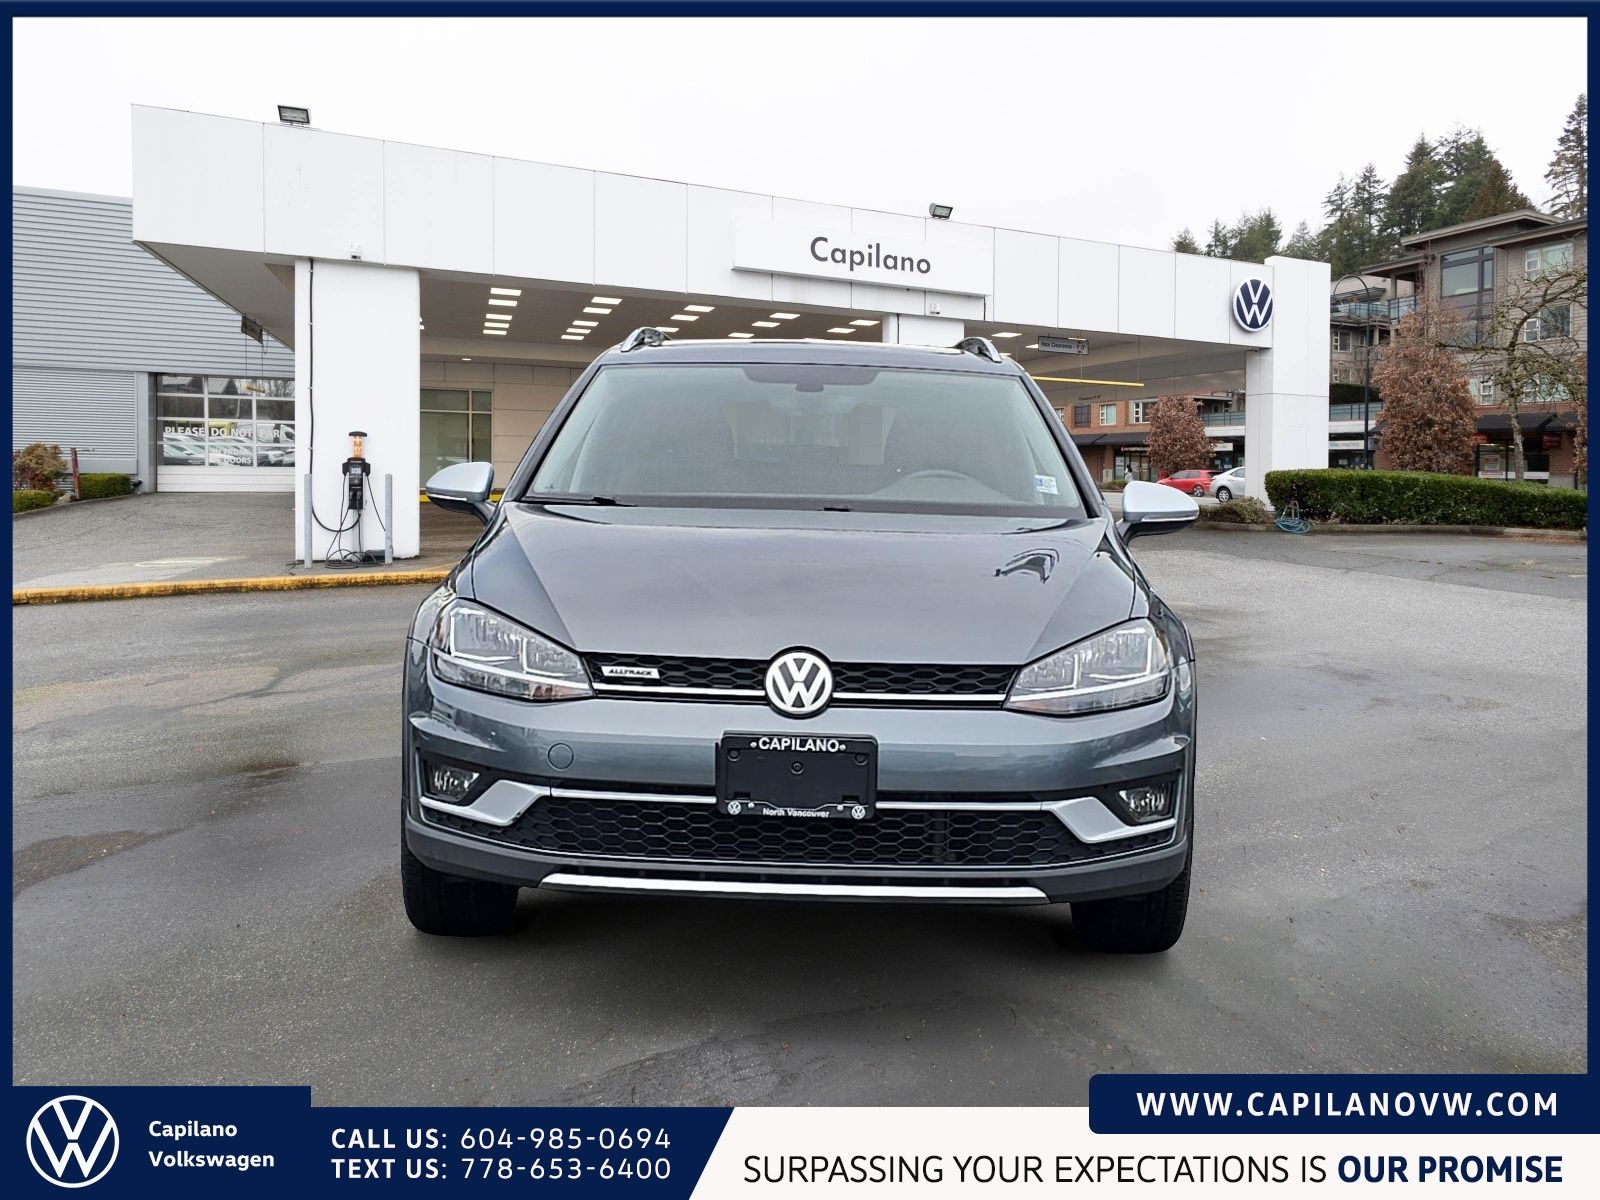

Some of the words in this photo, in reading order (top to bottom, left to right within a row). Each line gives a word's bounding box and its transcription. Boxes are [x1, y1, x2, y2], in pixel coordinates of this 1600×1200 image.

[810, 236, 931, 274] Capilano
[164, 426, 206, 436] PLEASE
[211, 427, 226, 436] DO
[230, 427, 253, 437] NOT
[608, 668, 653, 676] ALLTRACK
[758, 736, 840, 753] CAPILANO
[762, 807, 786, 817] North
[786, 808, 831, 819] Vancouver
